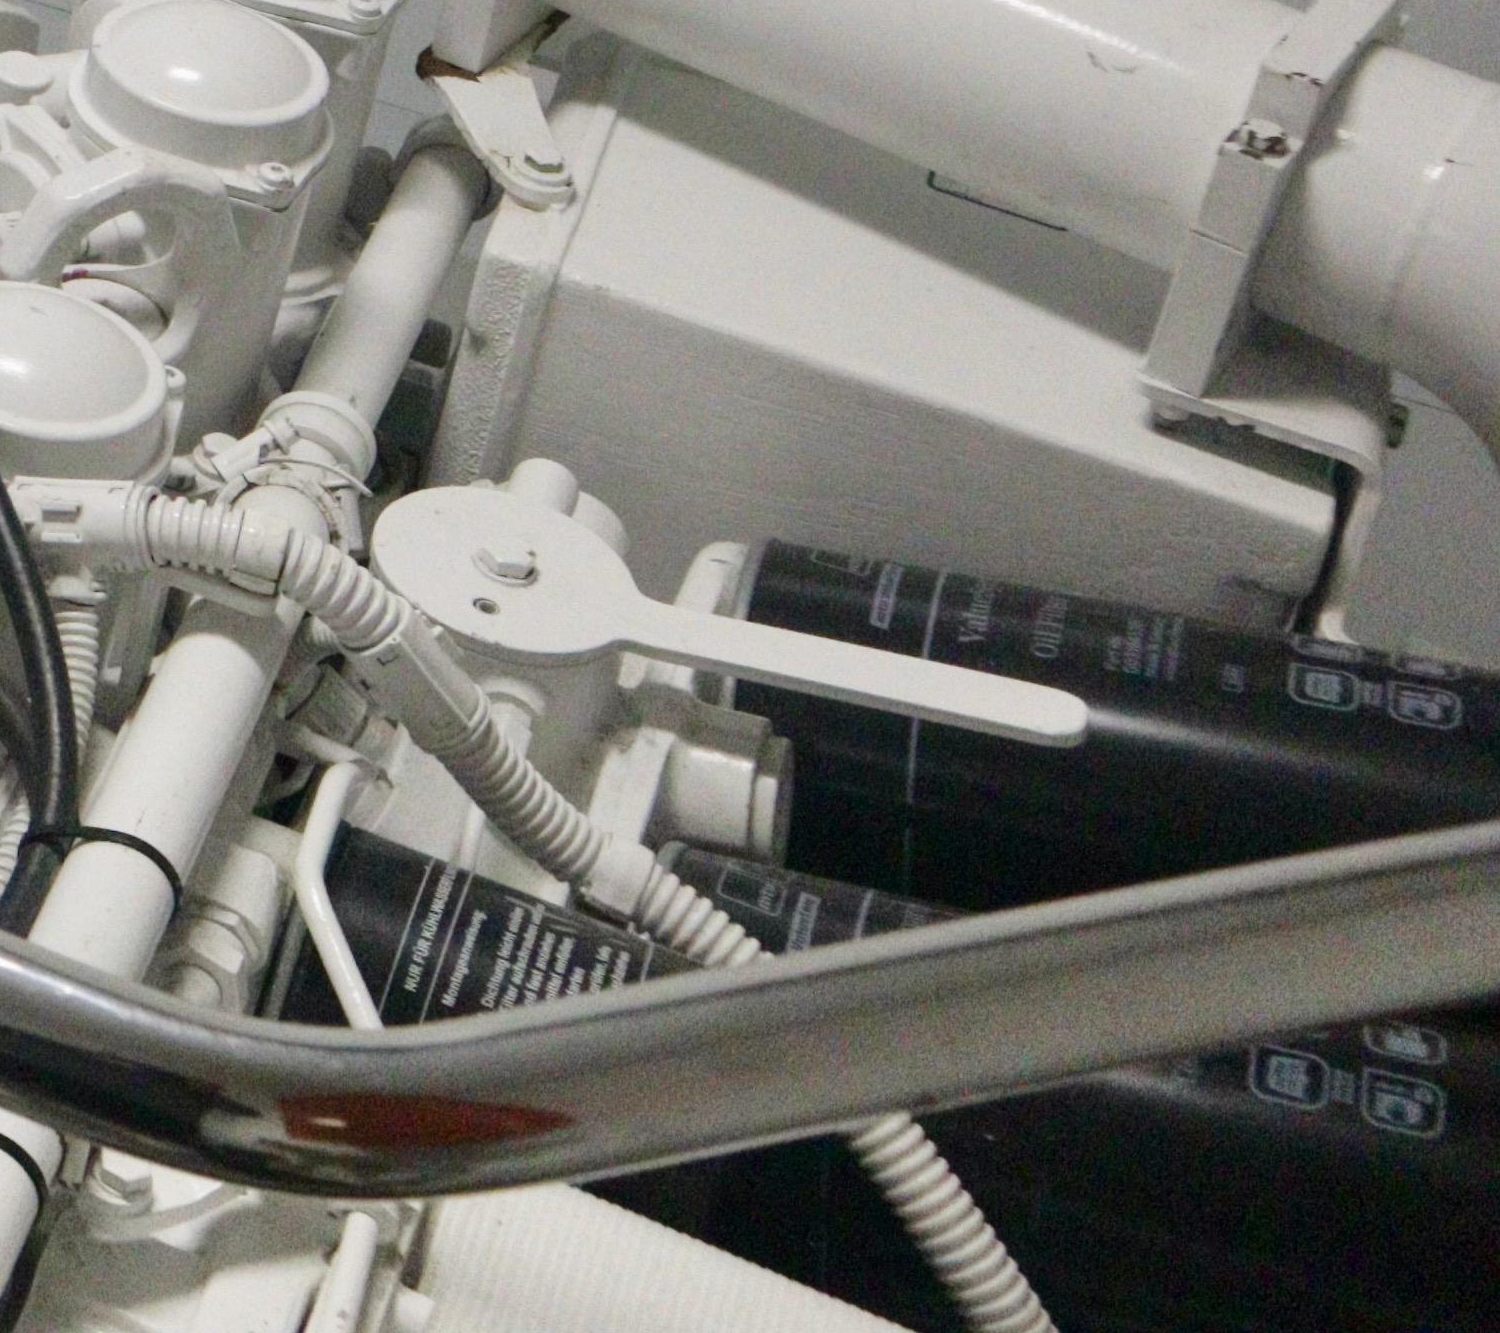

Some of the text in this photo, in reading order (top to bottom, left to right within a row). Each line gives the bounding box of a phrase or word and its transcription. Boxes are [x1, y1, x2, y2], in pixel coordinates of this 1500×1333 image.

[412, 935, 432, 965] FÜR
[404, 965, 425, 993] NUR
[480, 956, 511, 1010] Dichtung
